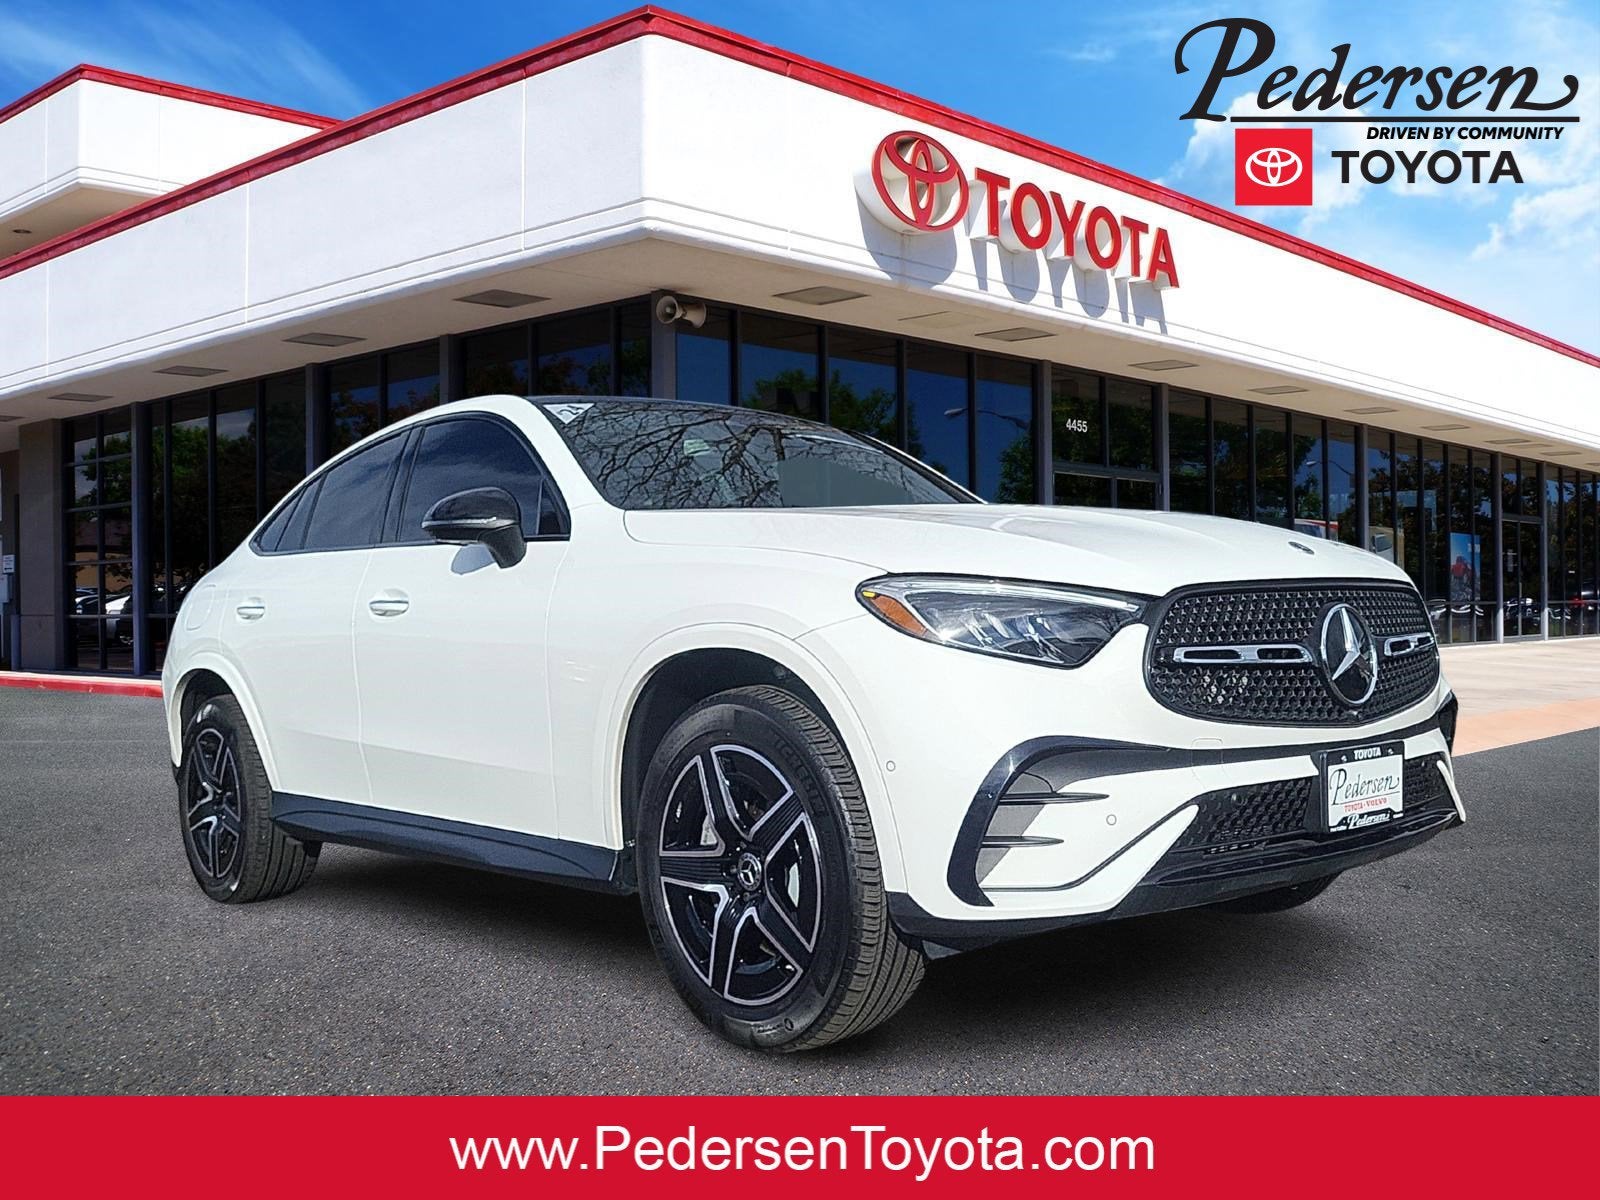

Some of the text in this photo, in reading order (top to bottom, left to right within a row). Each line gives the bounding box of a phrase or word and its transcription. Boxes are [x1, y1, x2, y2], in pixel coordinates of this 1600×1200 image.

[974, 166, 1180, 289] TOYOTA
[1065, 418, 1088, 433] 4455
[1353, 746, 1382, 761] TOYOTA
[1329, 768, 1400, 806] Pedersen
